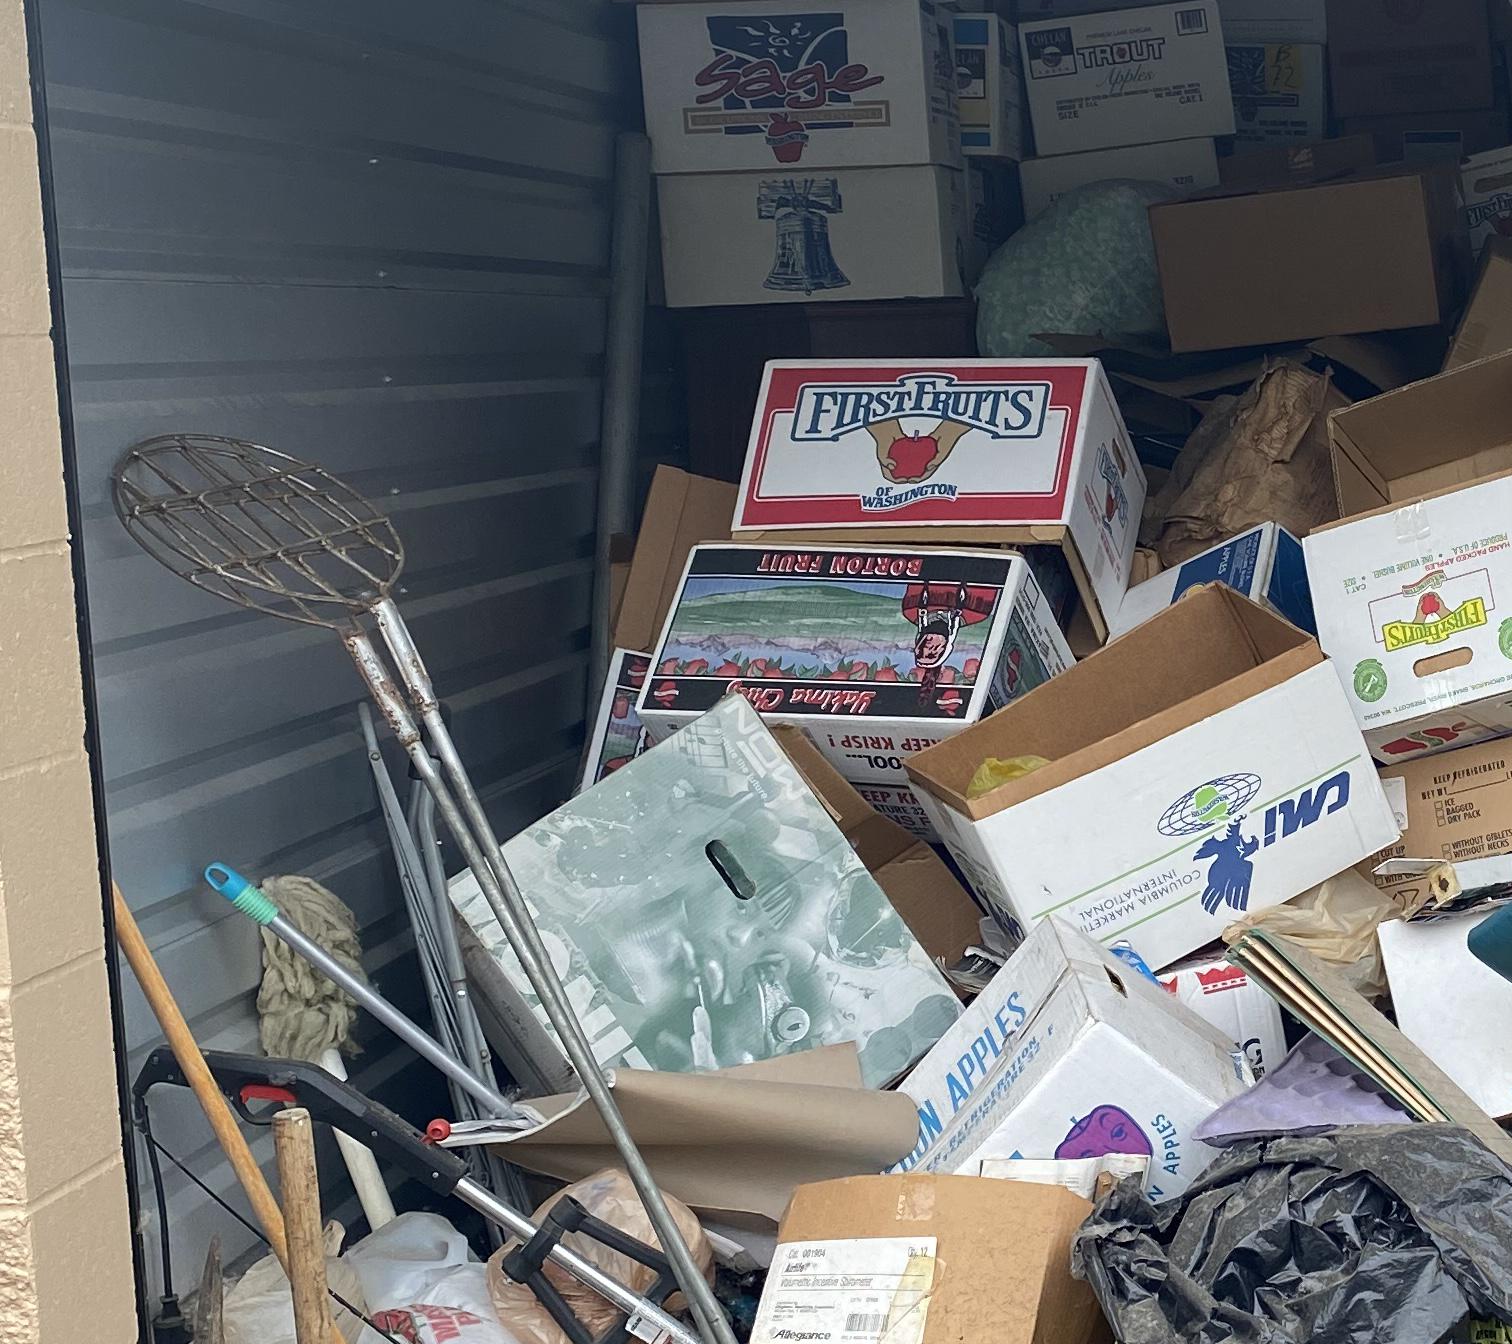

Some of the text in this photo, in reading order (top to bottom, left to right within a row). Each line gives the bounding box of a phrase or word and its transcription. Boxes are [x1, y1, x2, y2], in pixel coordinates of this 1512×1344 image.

[1076, 37, 1165, 69] TROUT
[1096, 64, 1158, 96] Apples
[861, 482, 959, 509] WASHINGTON
[876, 485, 894, 497] OF
[1469, 539, 1479, 550] OF
[1479, 532, 1508, 548] PRODUCE
[756, 552, 924, 577] BORTON FRUIT
[1424, 541, 1511, 572] HAND PACKED APPLES
[1352, 581, 1367, 593] CAT
[725, 679, 878, 714] Yakima Chi
[724, 701, 807, 801] NOW
[841, 735, 895, 751] KRISP
[735, 759, 748, 775] the
[845, 753, 903, 770] OOL...
[1444, 797, 1456, 807] ICE
[1445, 802, 1474, 816] BAGGED
[1447, 809, 1482, 825] DRY PACK
[1451, 828, 1512, 850] WITHOUT GIBLETS
[1452, 839, 1510, 859] WITHOUT NECKS
[1395, 845, 1406, 856] UP
[1079, 869, 1177, 918] INTERNATIONAL
[1079, 869, 1201, 934] COLUMBIA MARKETI
[945, 990, 1027, 1115] APPLES
[1150, 1113, 1182, 1176] APPLES
